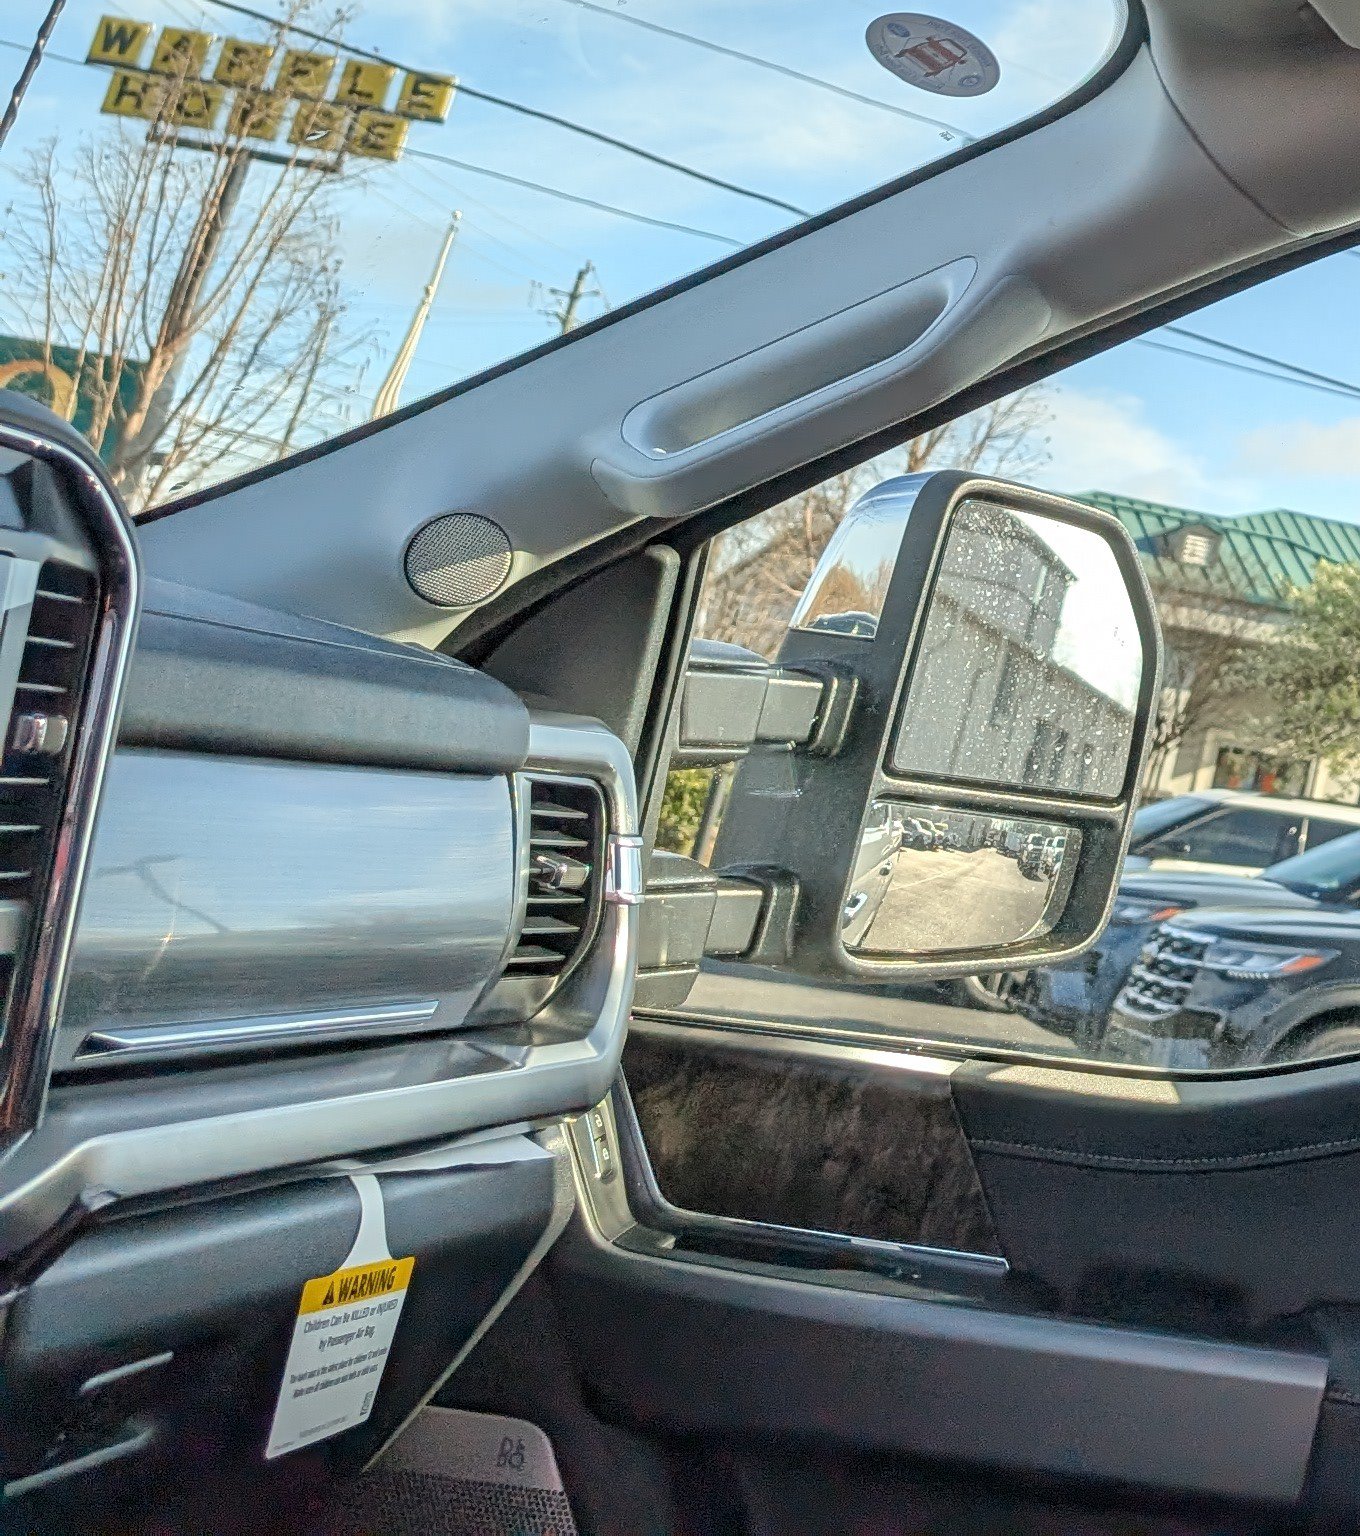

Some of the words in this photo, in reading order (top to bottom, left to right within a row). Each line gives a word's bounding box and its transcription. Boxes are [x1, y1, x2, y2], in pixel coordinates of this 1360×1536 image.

[338, 1266, 397, 1303] WARNING
[304, 1318, 330, 1333] Children
[330, 1314, 342, 1326] Can
